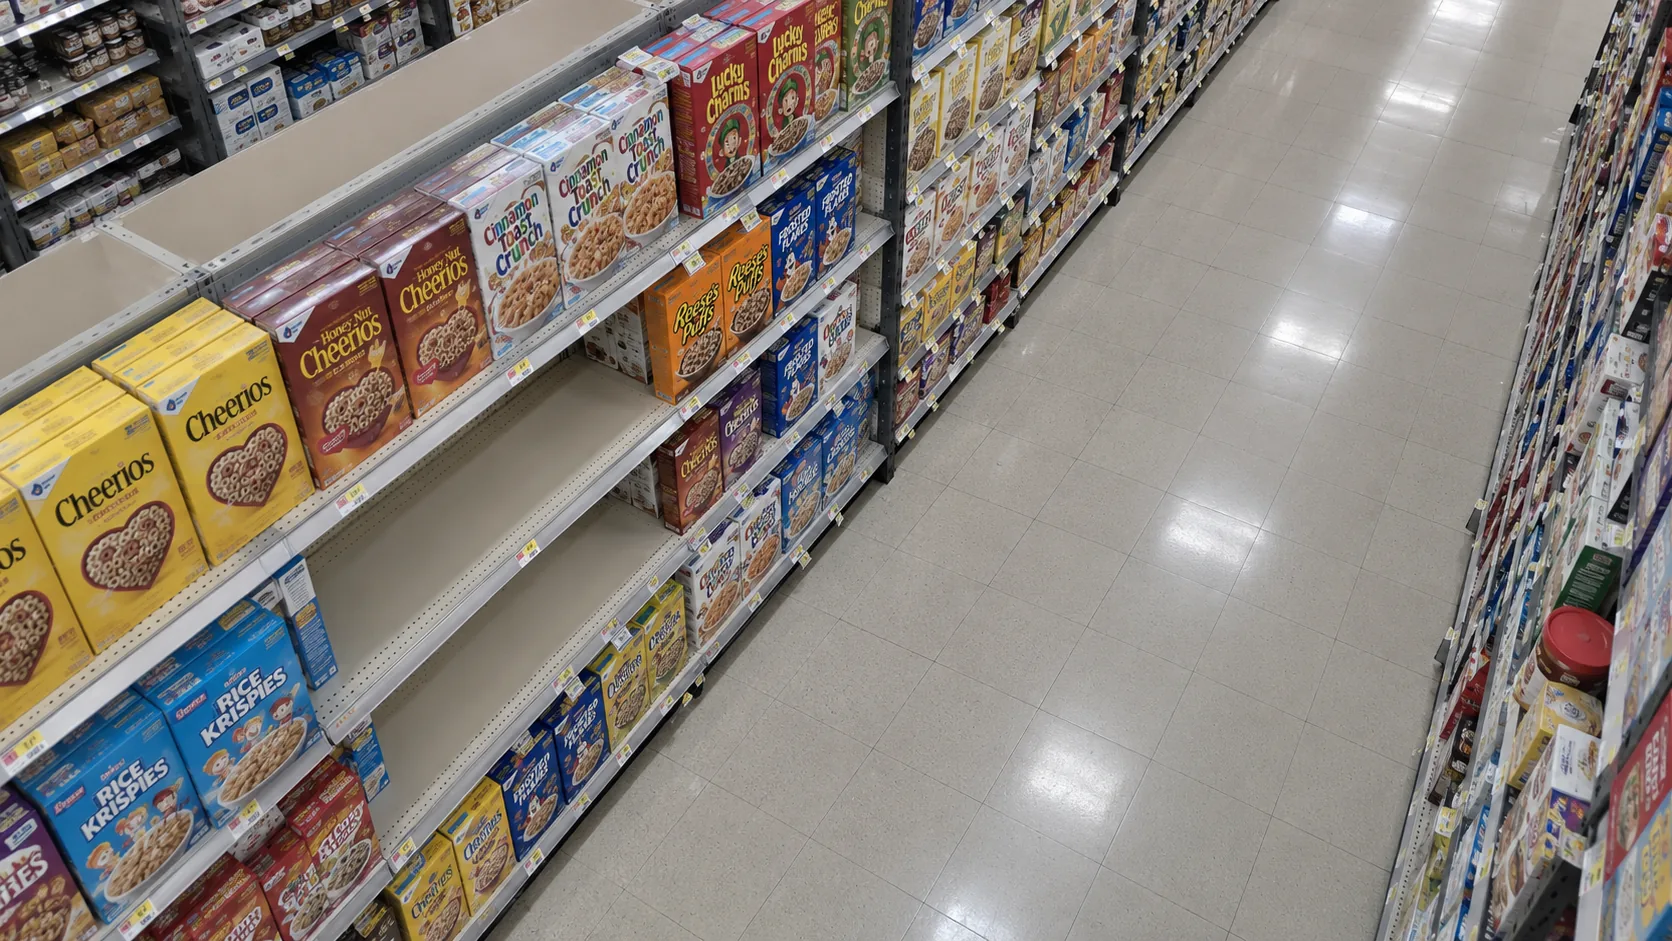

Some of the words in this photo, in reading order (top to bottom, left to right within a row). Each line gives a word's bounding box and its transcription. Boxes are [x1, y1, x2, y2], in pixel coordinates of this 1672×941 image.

[767, 42, 808, 85] Charms
[773, 24, 804, 58] Lucky
[706, 81, 750, 124] Charms
[710, 63, 745, 99] Lucky
[619, 109, 664, 154] Cinnamon
[629, 128, 658, 161] Toast
[559, 149, 608, 198] Cinnamon
[627, 136, 665, 183] Crunch
[568, 177, 611, 227] Crunch
[571, 167, 602, 205] Toast
[484, 193, 539, 246] Cinnamon
[498, 212, 532, 252] Toast
[416, 261, 444, 282] Honey
[444, 246, 461, 264] Nut
[496, 222, 543, 276] Crunch
[399, 255, 468, 315] Cheerios
[299, 313, 382, 380] Cheerios
[320, 317, 353, 346] Honey
[353, 305, 373, 325] Nut
[185, 375, 272, 443] Cheerios
[54, 450, 155, 528] Cheerios
[200, 667, 287, 747] KRISPIES
[215, 668, 262, 715] RICE
[80, 758, 169, 842] KRISPIES
[95, 759, 144, 807] RICE
